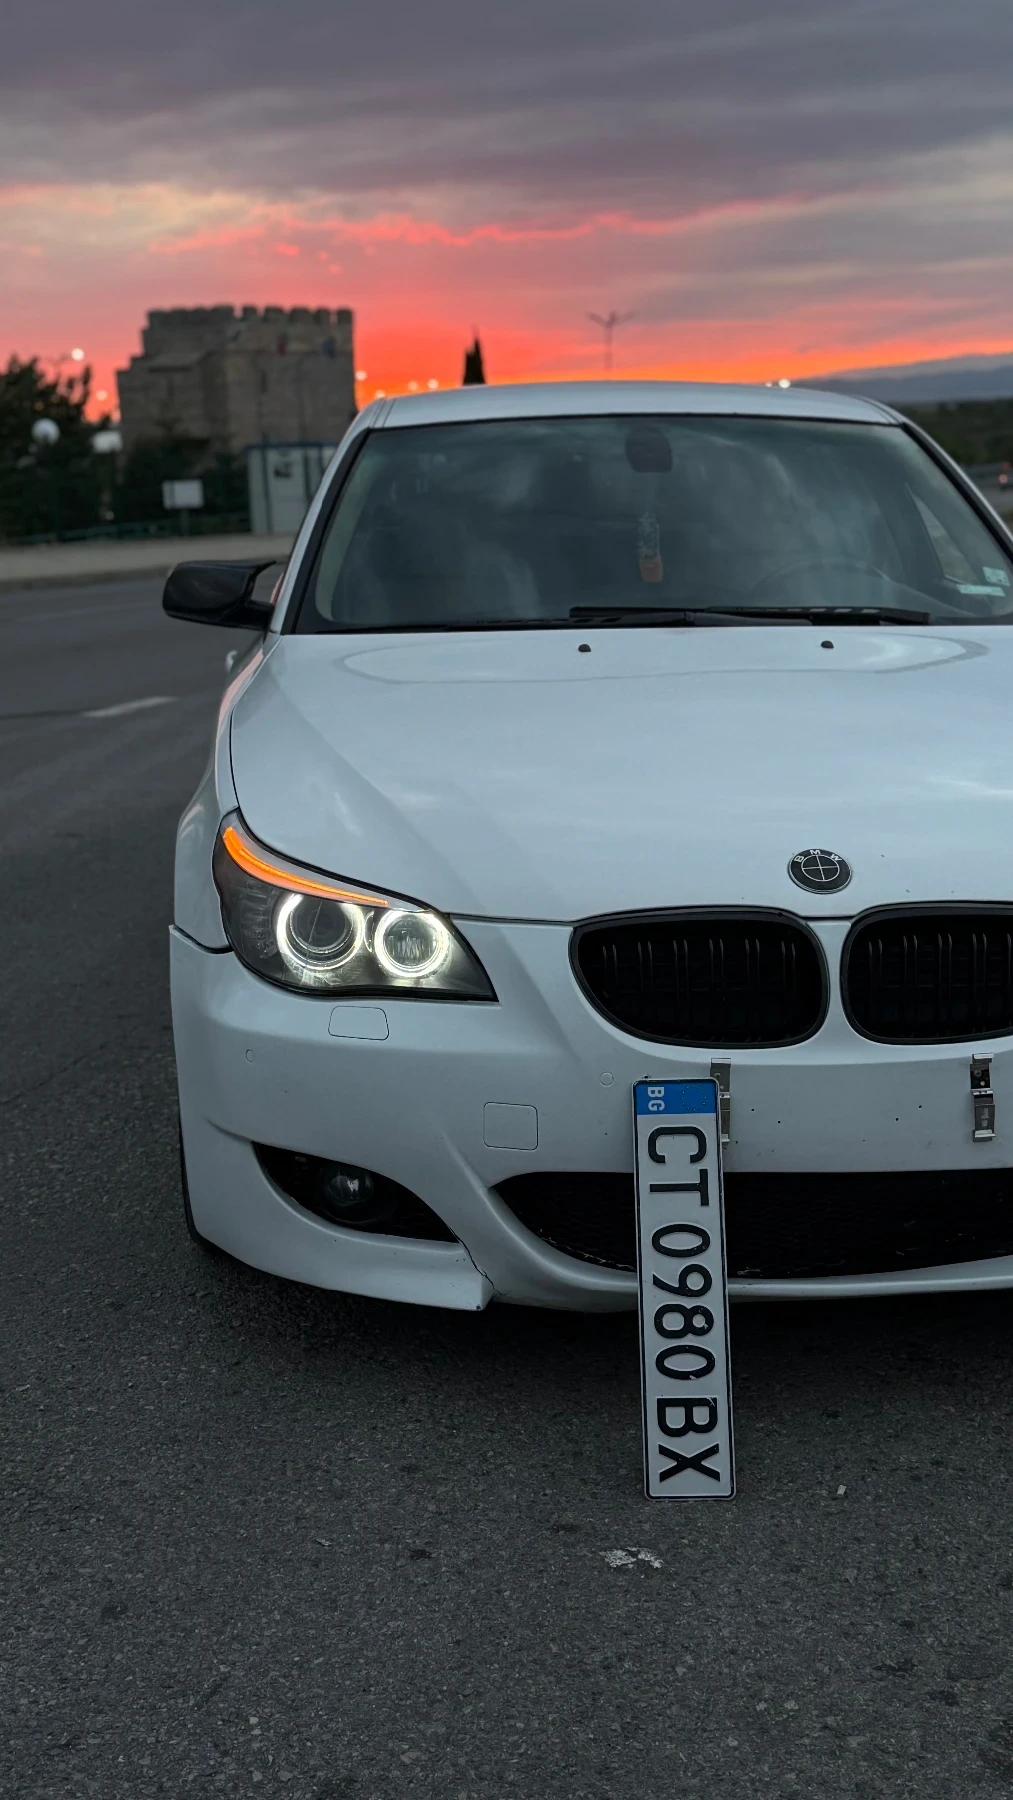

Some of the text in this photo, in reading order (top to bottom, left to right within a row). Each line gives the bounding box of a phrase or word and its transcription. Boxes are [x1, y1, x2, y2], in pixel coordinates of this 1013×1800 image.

[793, 849, 843, 863] BMW
[647, 1086, 665, 1112] BG
[647, 1125, 721, 1483] CT 0980 BX
